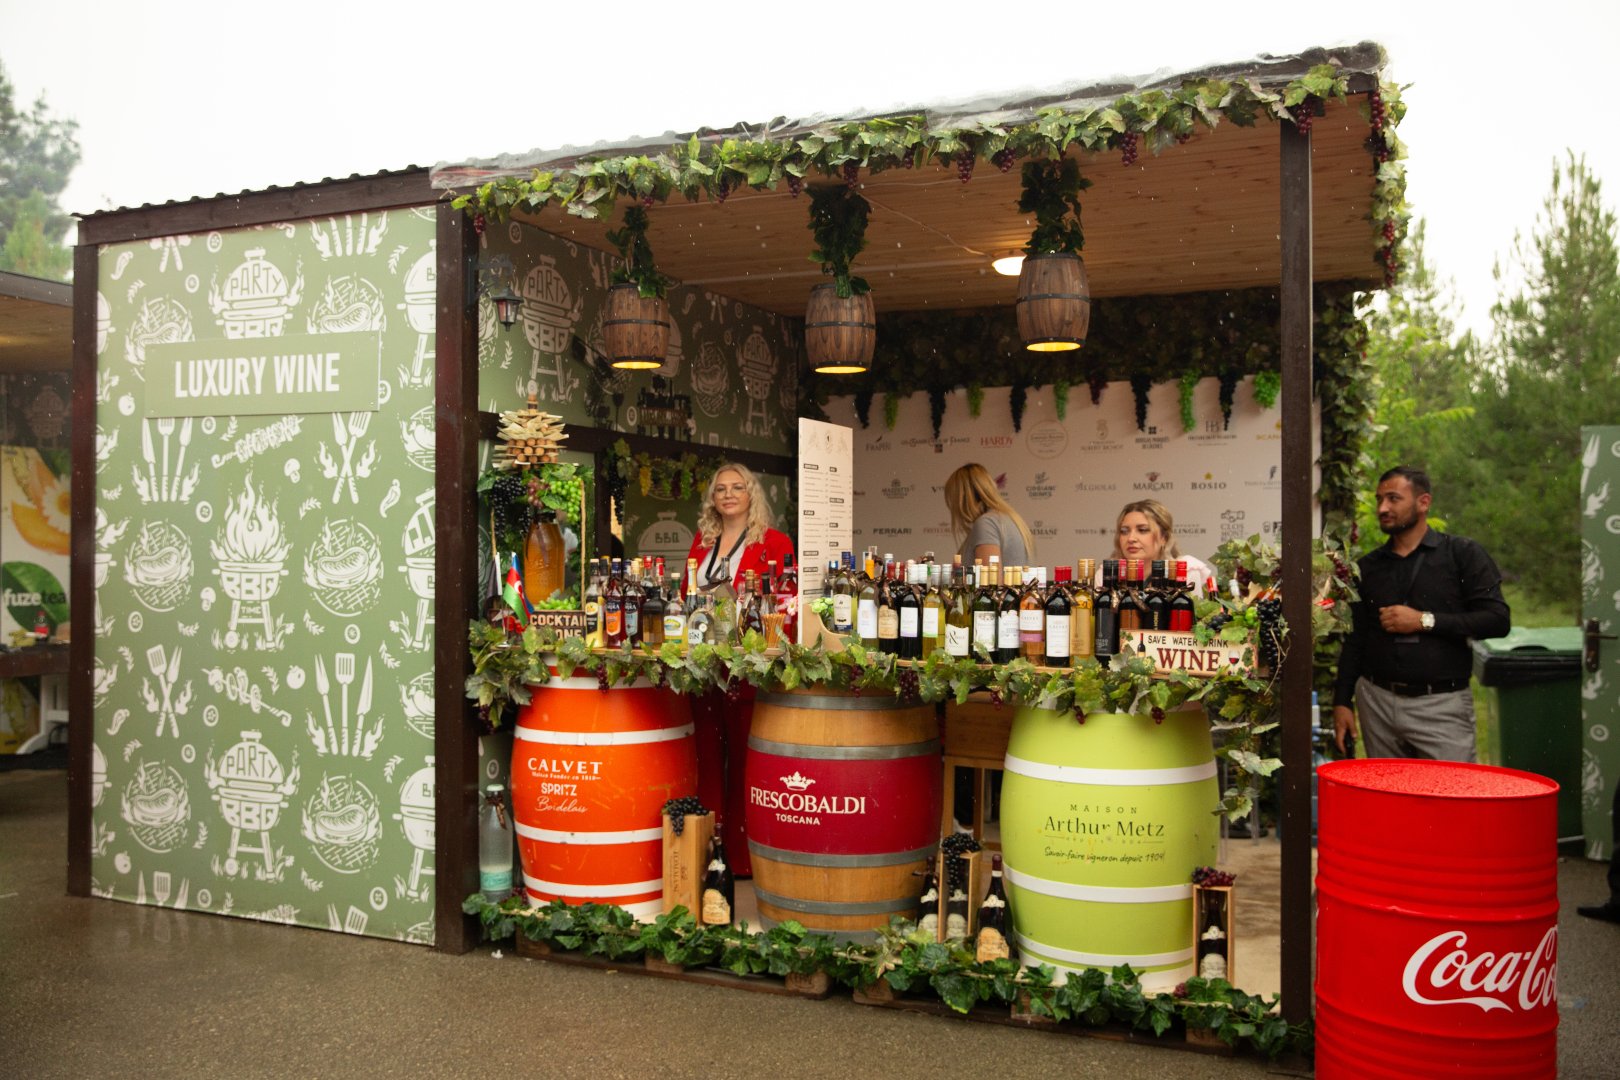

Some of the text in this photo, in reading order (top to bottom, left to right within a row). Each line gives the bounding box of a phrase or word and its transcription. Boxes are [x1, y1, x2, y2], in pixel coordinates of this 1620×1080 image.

[230, 263, 282, 297] PARTY
[528, 269, 568, 304] PARTY
[524, 318, 569, 354] BBQ
[175, 352, 341, 398] LUXURY WINE
[980, 436, 1014, 445] HARDY
[1133, 482, 1174, 491] MARCATI
[1191, 482, 1227, 490] BOSIO
[655, 532, 680, 543] BBQ
[221, 571, 280, 600] BBQ
[4, 588, 42, 607] fuze
[240, 606, 262, 614] TIME
[555, 629, 582, 640] ONE
[1148, 635, 1229, 648] SAVE WATER RINK
[1156, 647, 1221, 672] WINE
[226, 745, 278, 778] PARTY
[527, 757, 603, 774] CALVET
[541, 782, 577, 796] SPRITZ
[750, 786, 866, 815] FRESCOBALDI
[1070, 804, 1137, 814] MAISON
[221, 797, 280, 831] BBQ
[775, 813, 821, 825] TOSCANA
[1044, 816, 1165, 837] Arthur Metz
[1119, 853, 1143, 864] depuis
[1402, 924, 1558, 1011] Coca-Co
